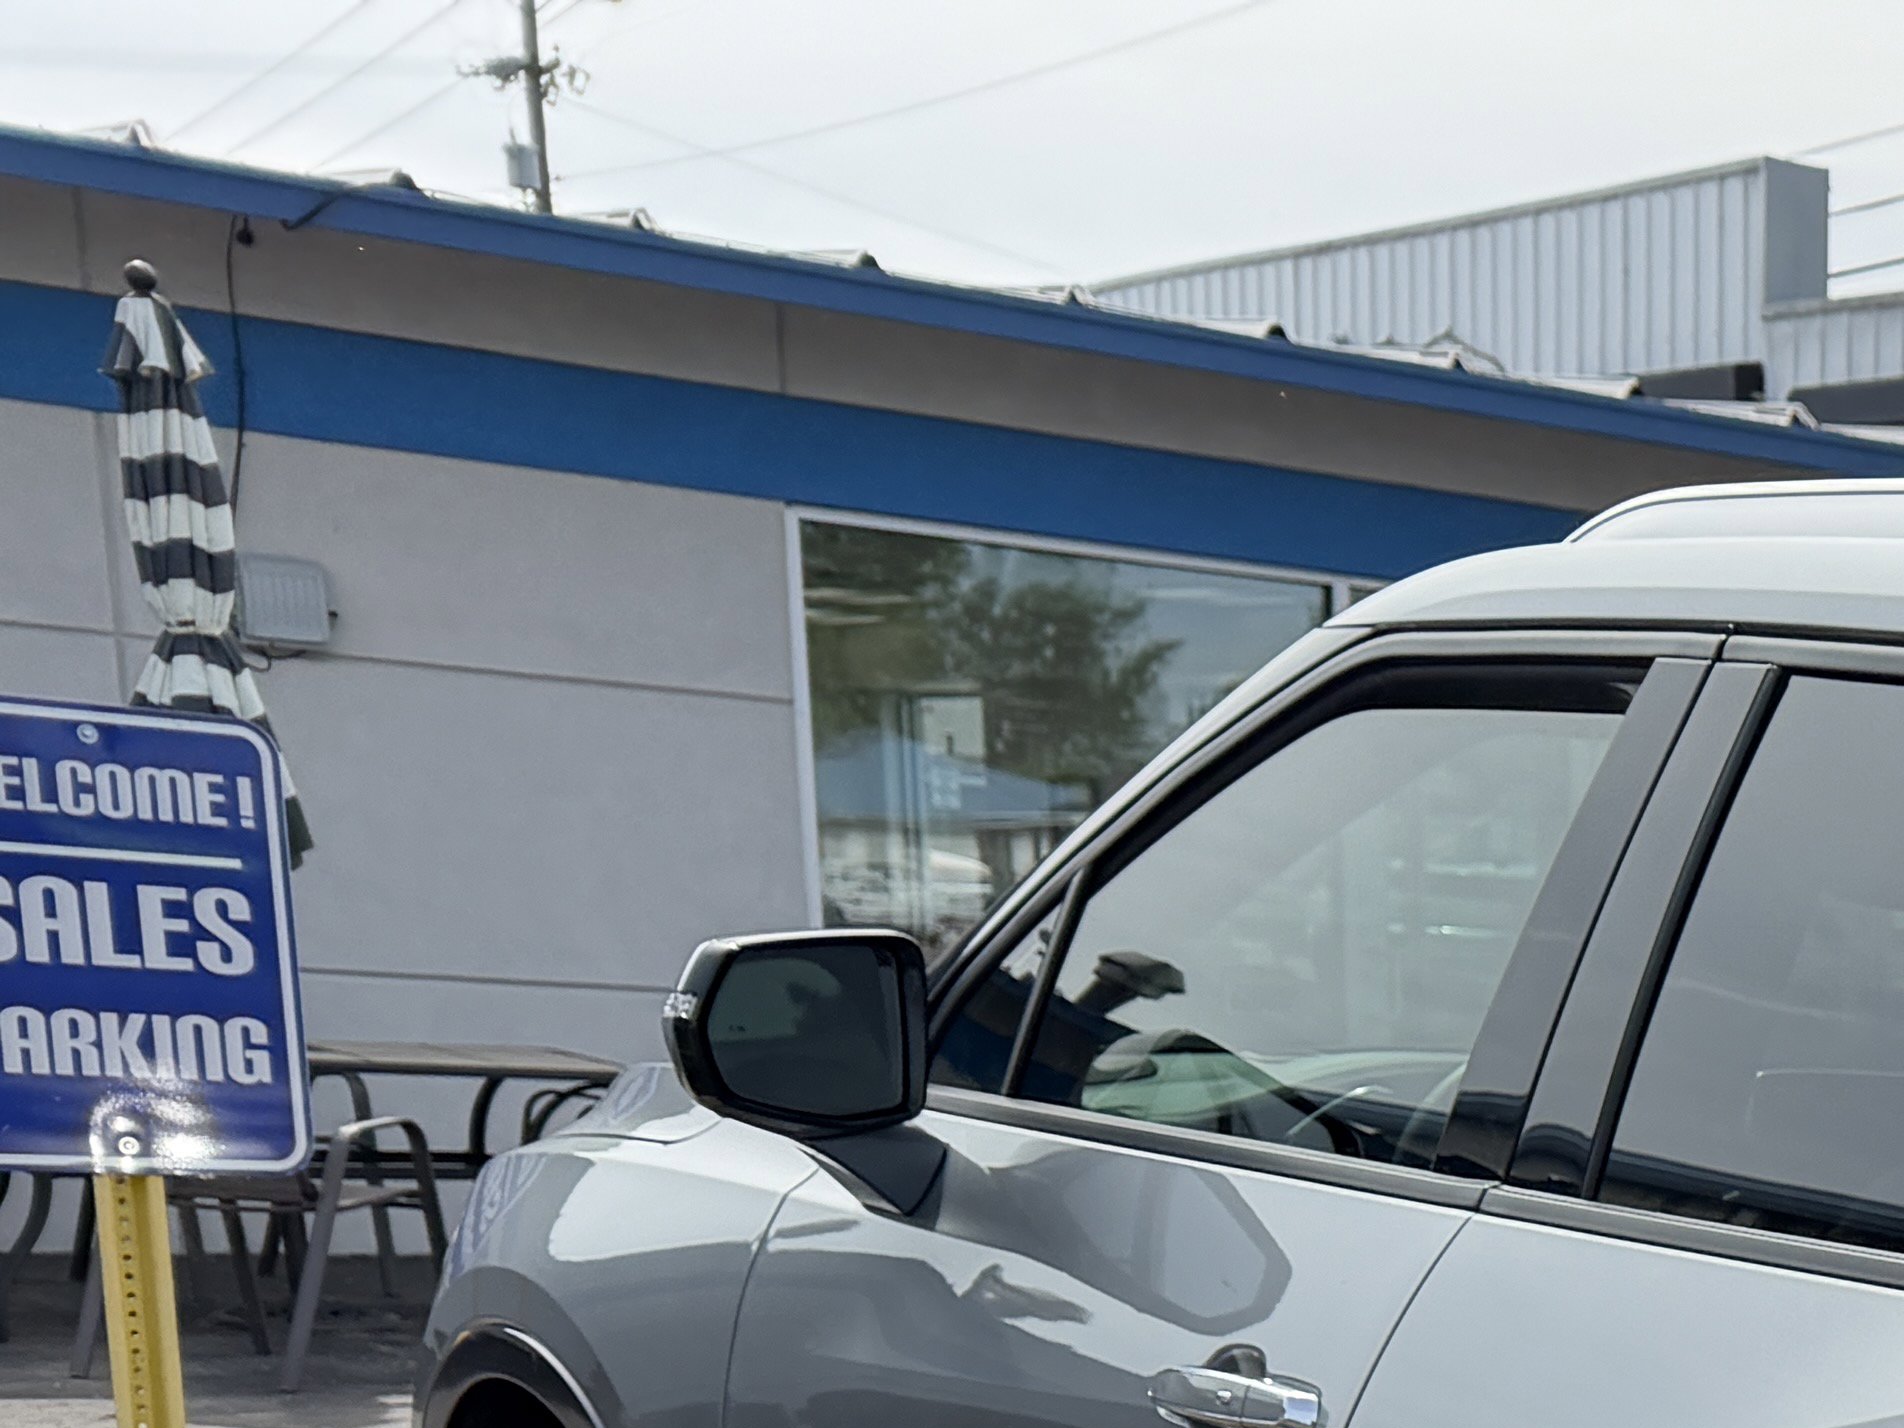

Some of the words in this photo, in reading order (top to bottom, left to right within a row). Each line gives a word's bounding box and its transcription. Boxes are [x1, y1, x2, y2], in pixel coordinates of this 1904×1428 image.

[0, 754, 257, 830] ELCOME!
[0, 874, 256, 977] ALES
[0, 1005, 273, 1085] ARKING
